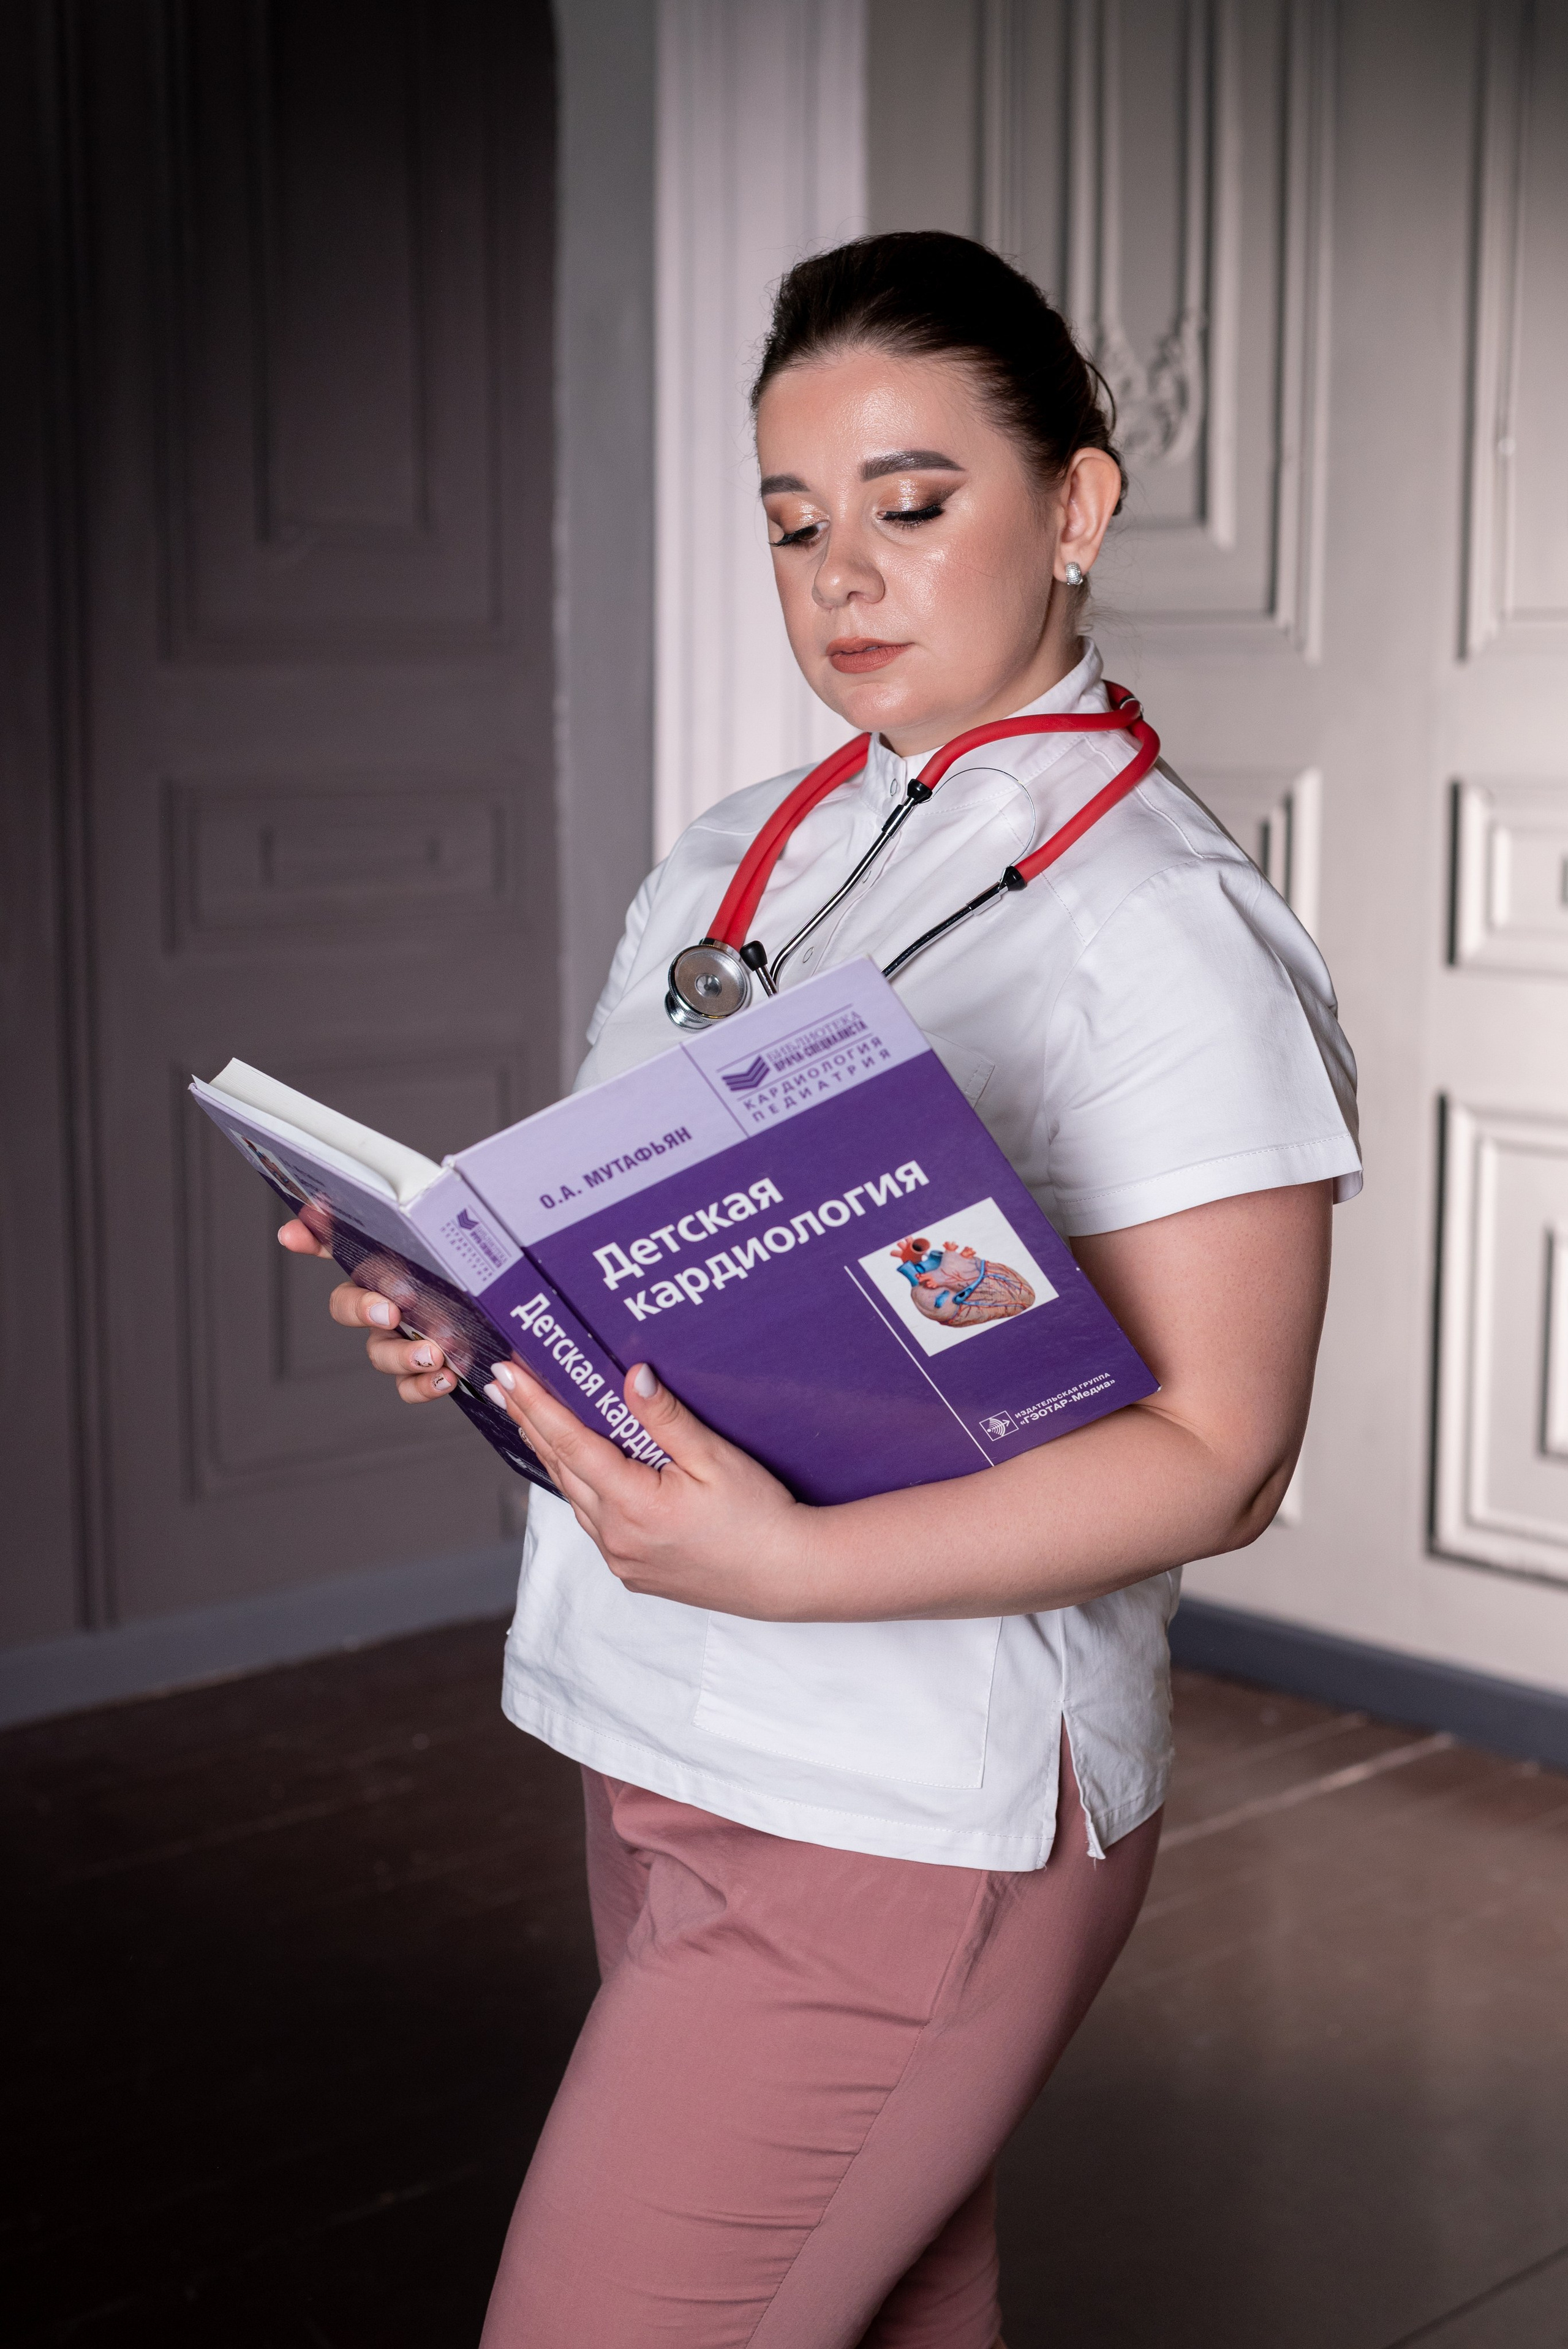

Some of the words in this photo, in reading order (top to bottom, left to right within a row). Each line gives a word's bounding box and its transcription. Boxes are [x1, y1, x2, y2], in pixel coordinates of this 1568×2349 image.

[767, 1011, 861, 1060] БИБЛИОТЕКА
[743, 1036, 883, 1110] КАРДИОЛОГИЯ
[752, 1048, 891, 1122] ПЕДИАТРИЯ
[539, 1185, 582, 1209] О.А.
[583, 1126, 693, 1188] МУТАФЬЯН
[592, 1177, 784, 1290] Детская
[623, 1159, 930, 1321] кардиология
[510, 1292, 605, 1397] Детская
[1014, 1386, 1078, 1419] ИЗДАТЕЛЬСКАЯ
[1079, 1372, 1111, 1390] ГРУППА
[1020, 1379, 1115, 1425] «ГЭОТАР-Медиа»
